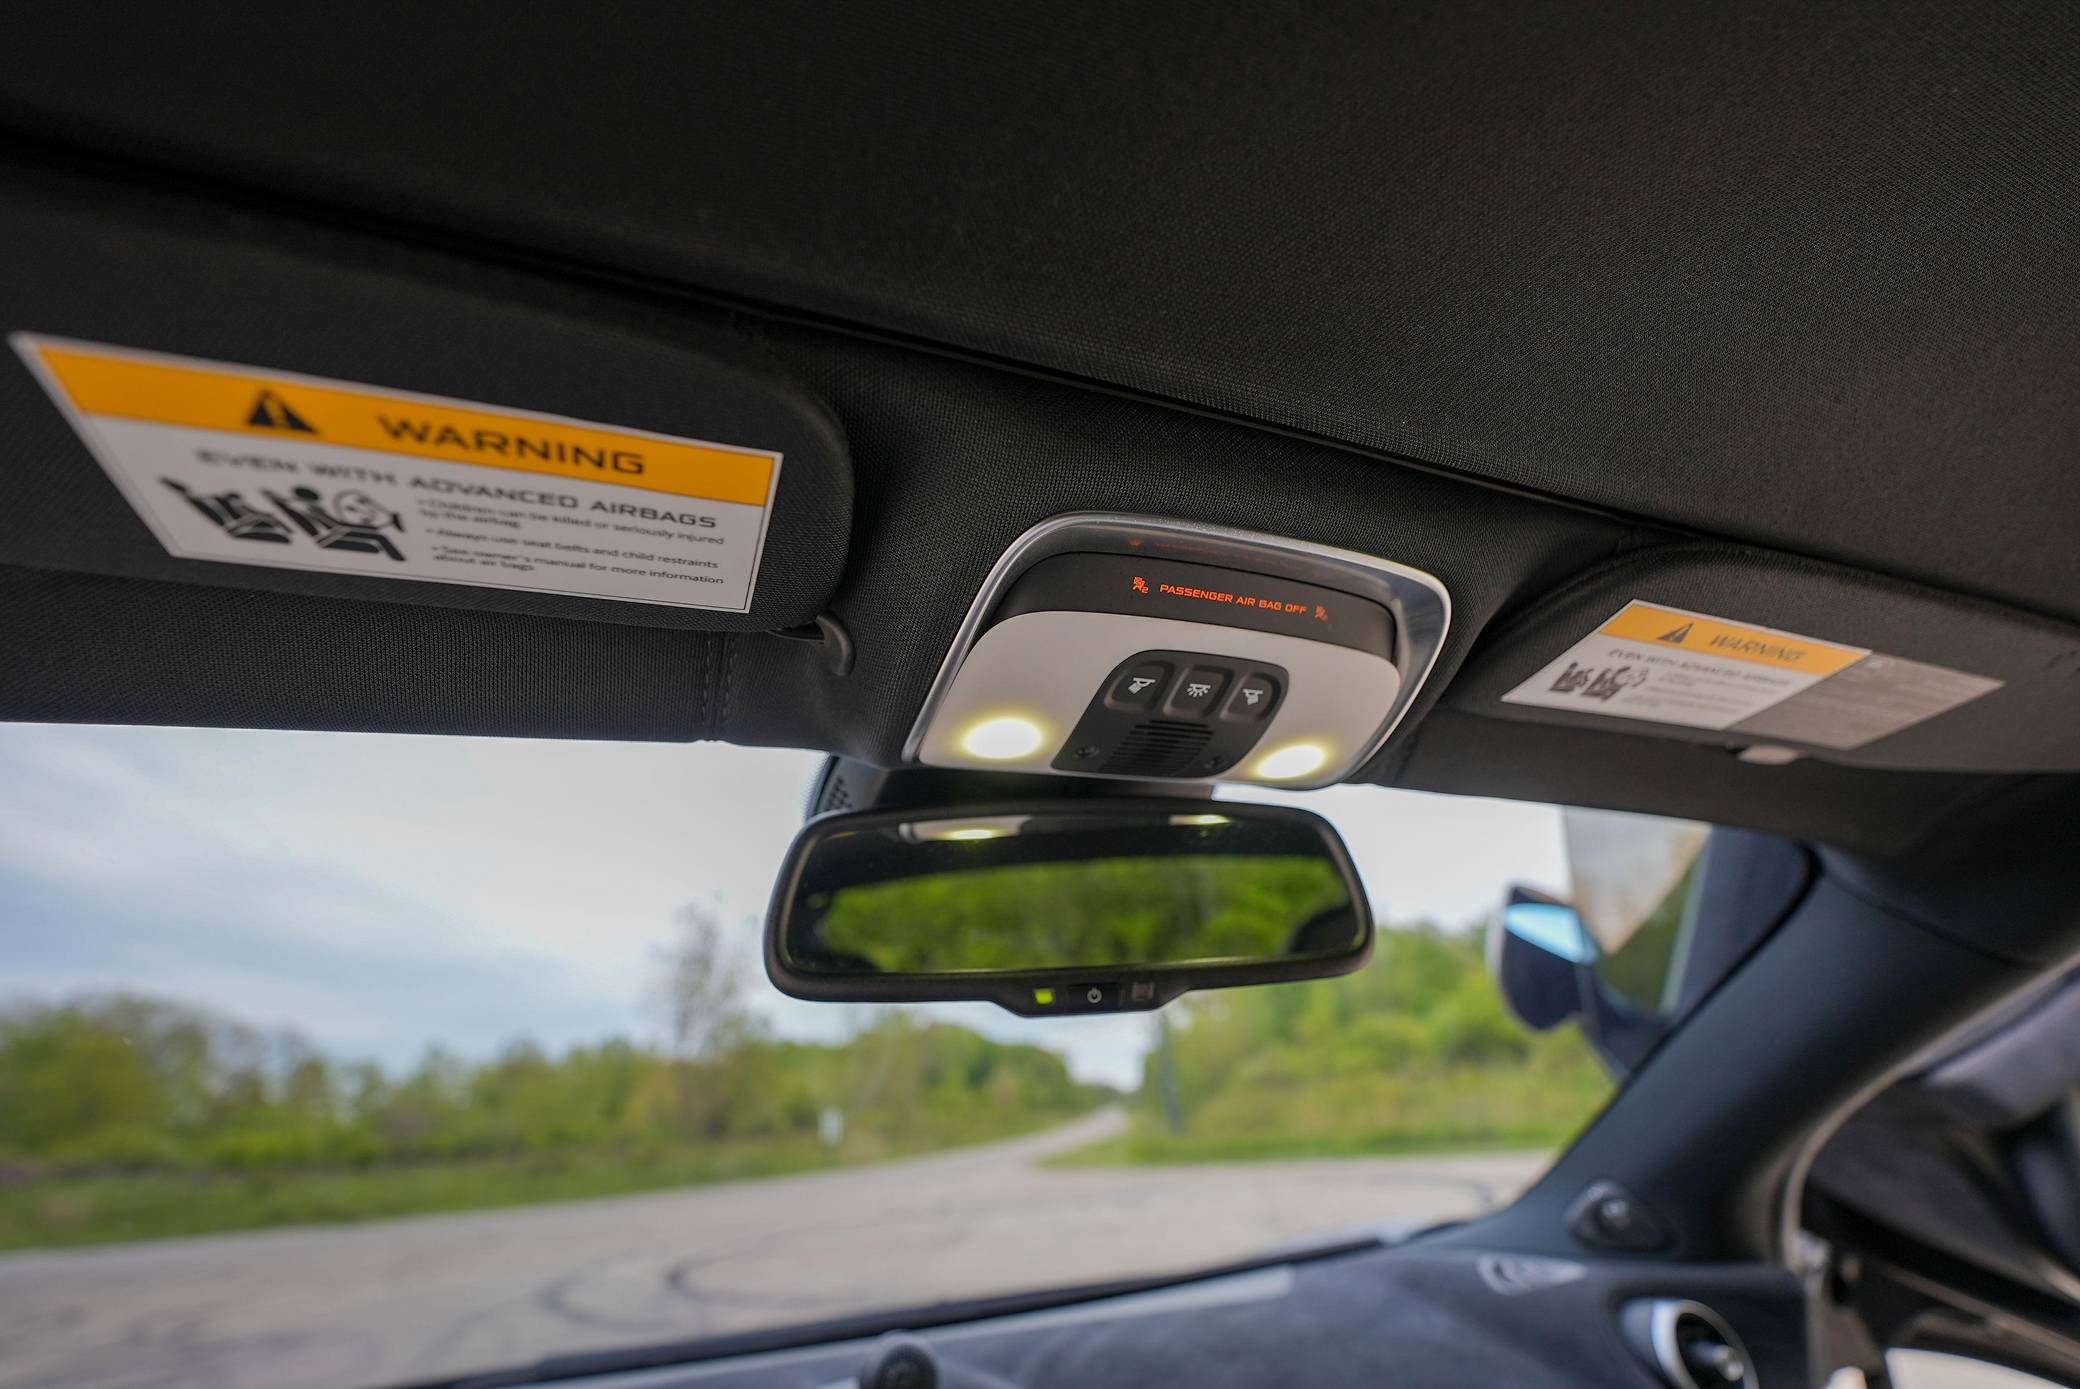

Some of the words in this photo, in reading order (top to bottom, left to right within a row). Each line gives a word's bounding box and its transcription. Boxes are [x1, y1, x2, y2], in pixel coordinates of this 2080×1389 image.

[377, 414, 645, 475] WARNING
[197, 449, 298, 472] EVEN
[305, 462, 397, 485] WITH
[409, 476, 578, 508] ADVANCED
[590, 499, 717, 528] AIRBAGS
[427, 500, 494, 515] Children
[529, 511, 549, 522] be
[552, 513, 591, 528] killed
[594, 521, 608, 530] or
[613, 523, 674, 540] seriously
[677, 531, 725, 546] injured
[443, 510, 468, 521] the
[437, 528, 487, 542] Always
[491, 536, 518, 545] use
[522, 539, 553, 550] seat
[554, 542, 590, 554] belts
[593, 546, 619, 558] and
[622, 549, 655, 562] child
[657, 554, 719, 569] restraints
[534, 556, 587, 569] manual
[589, 562, 608, 572] for
[611, 565, 647, 577] more
[649, 570, 725, 585] information
[1159, 584, 1234, 603] PASSENGER
[1236, 596, 1256, 607] AIR
[1259, 599, 1282, 611] BAG
[1285, 603, 1308, 615] OFF
[1709, 633, 1806, 663] WARNING
